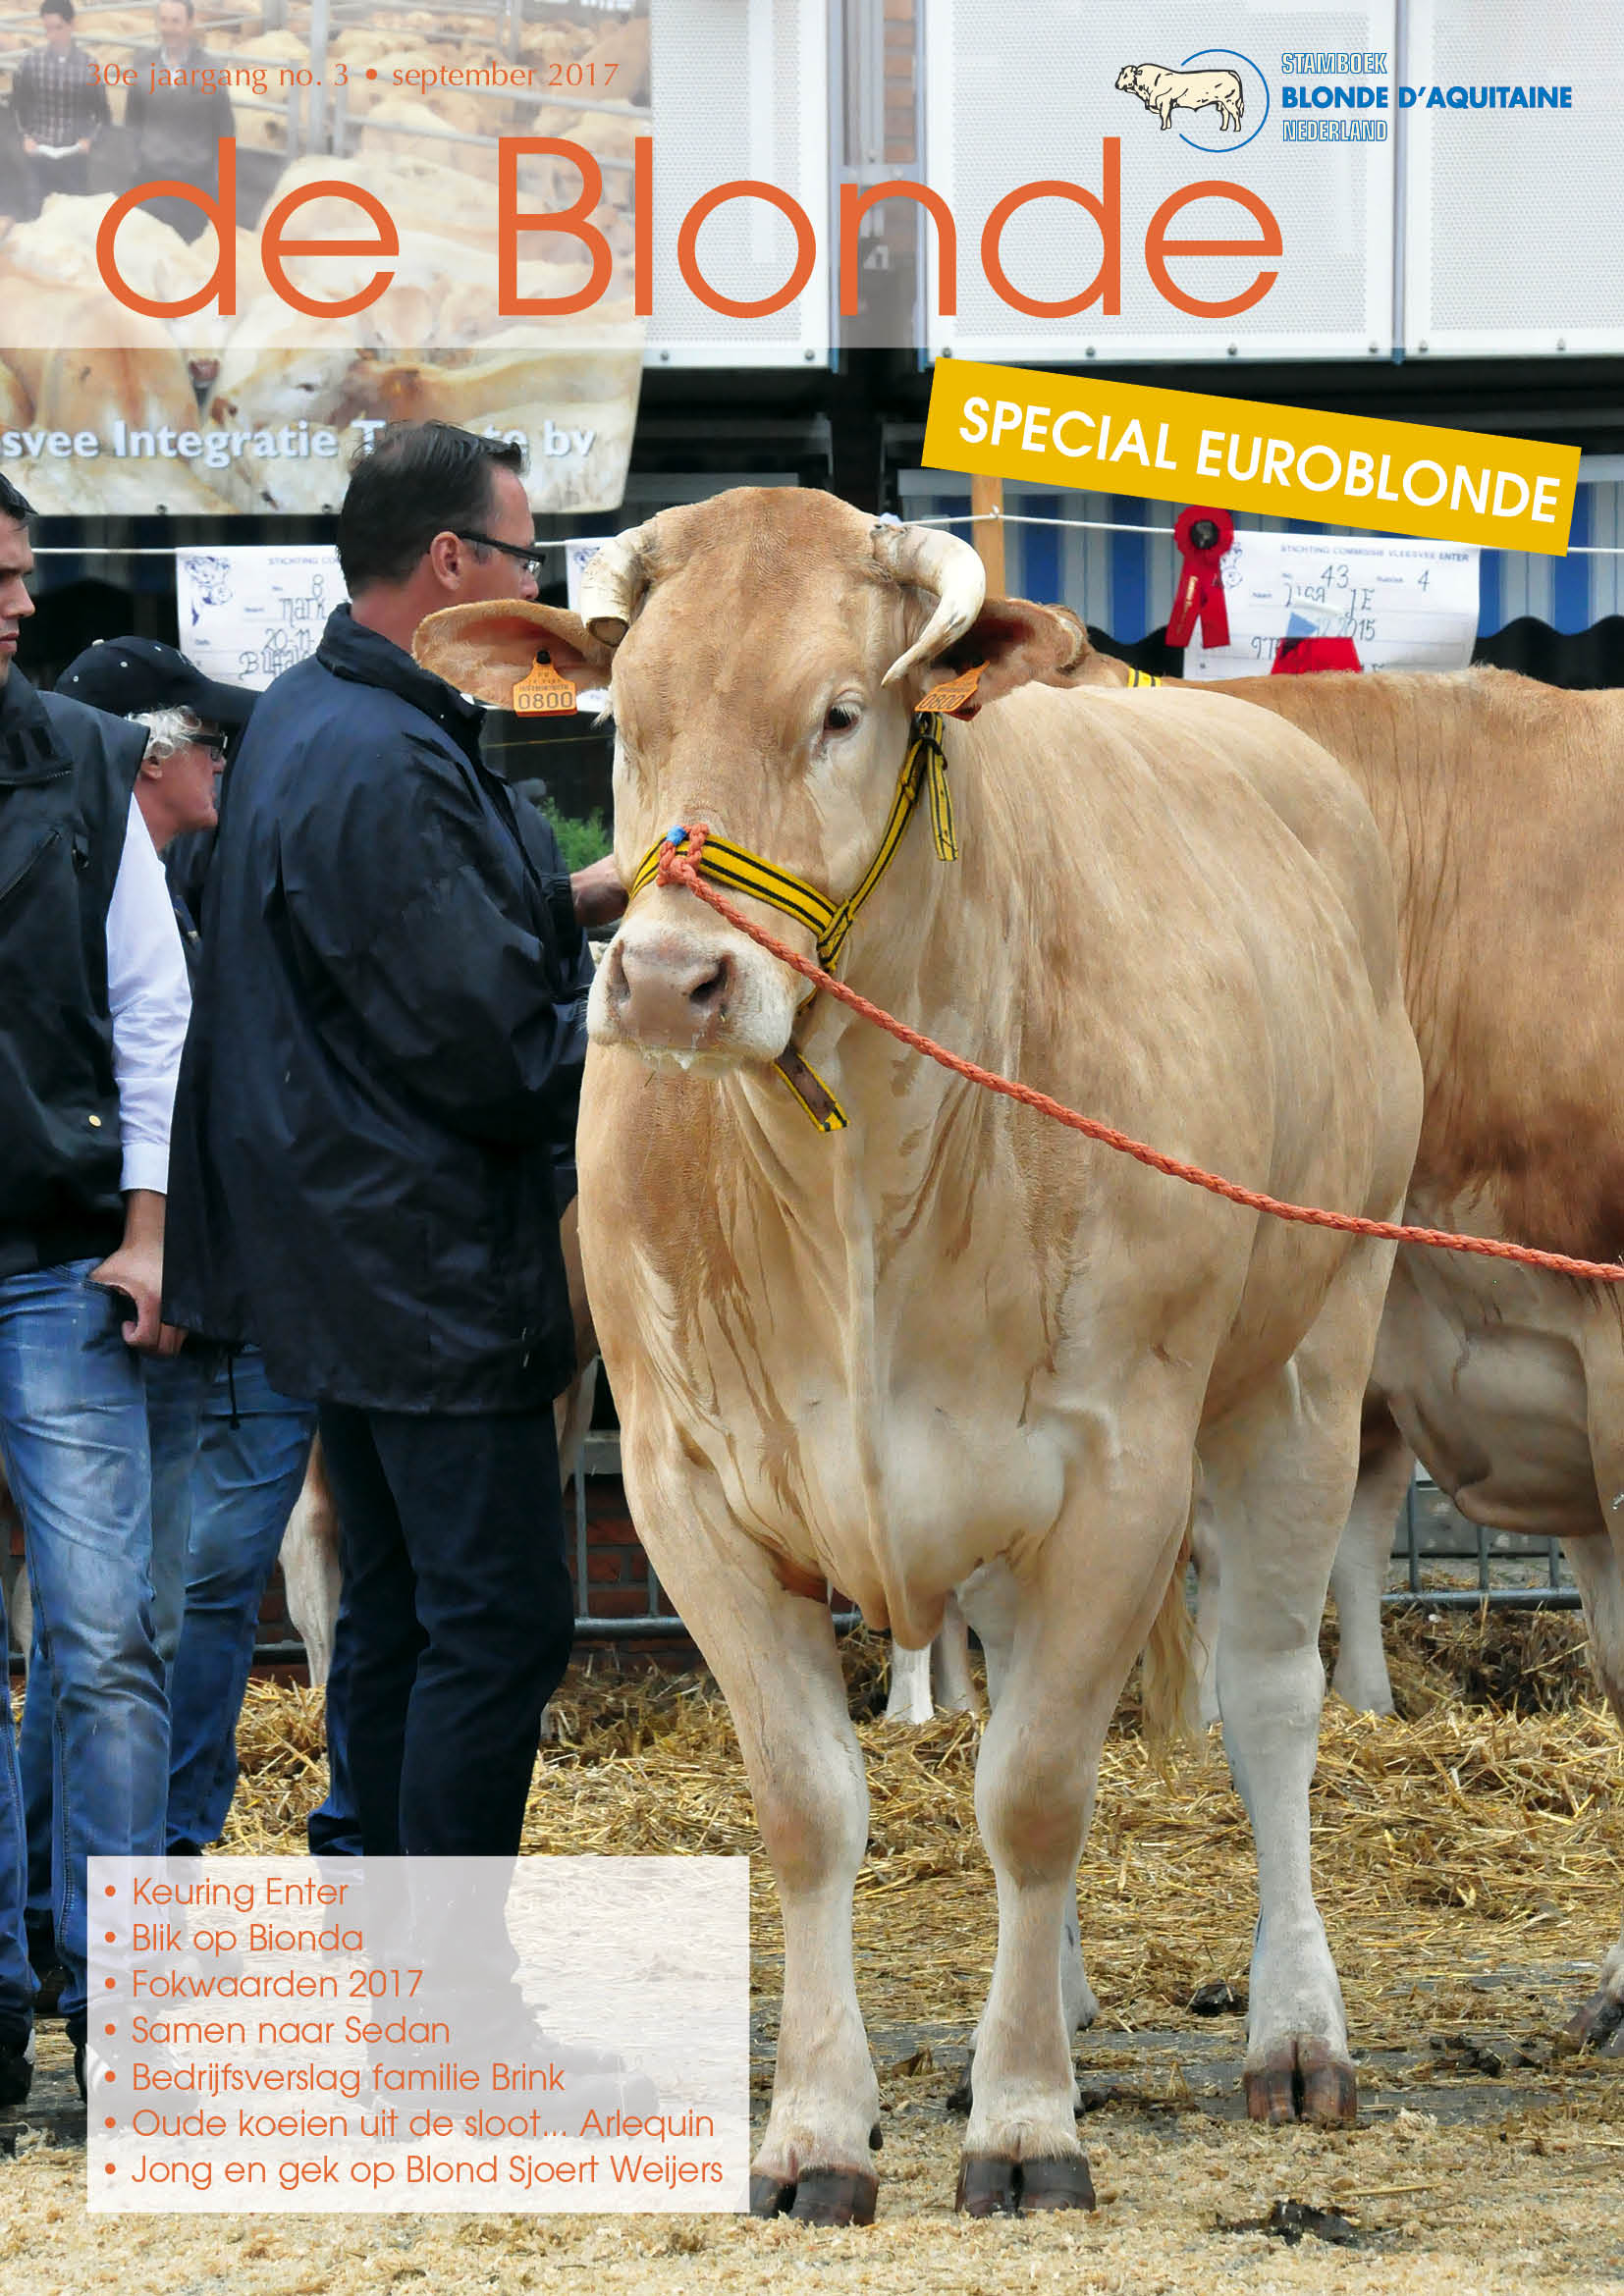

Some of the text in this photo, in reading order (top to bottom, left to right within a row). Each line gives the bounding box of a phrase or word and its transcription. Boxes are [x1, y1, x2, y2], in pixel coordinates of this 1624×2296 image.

[1, 430, 100, 458] svee
[113, 419, 340, 468] Integratie
[1438, 551, 1470, 562] ENTER
[312, 573, 324, 598] 8
[1321, 564, 1350, 589] 43
[1417, 568, 1431, 592] 4
[518, 691, 573, 710] 0800
[919, 693, 966, 709] 0800
